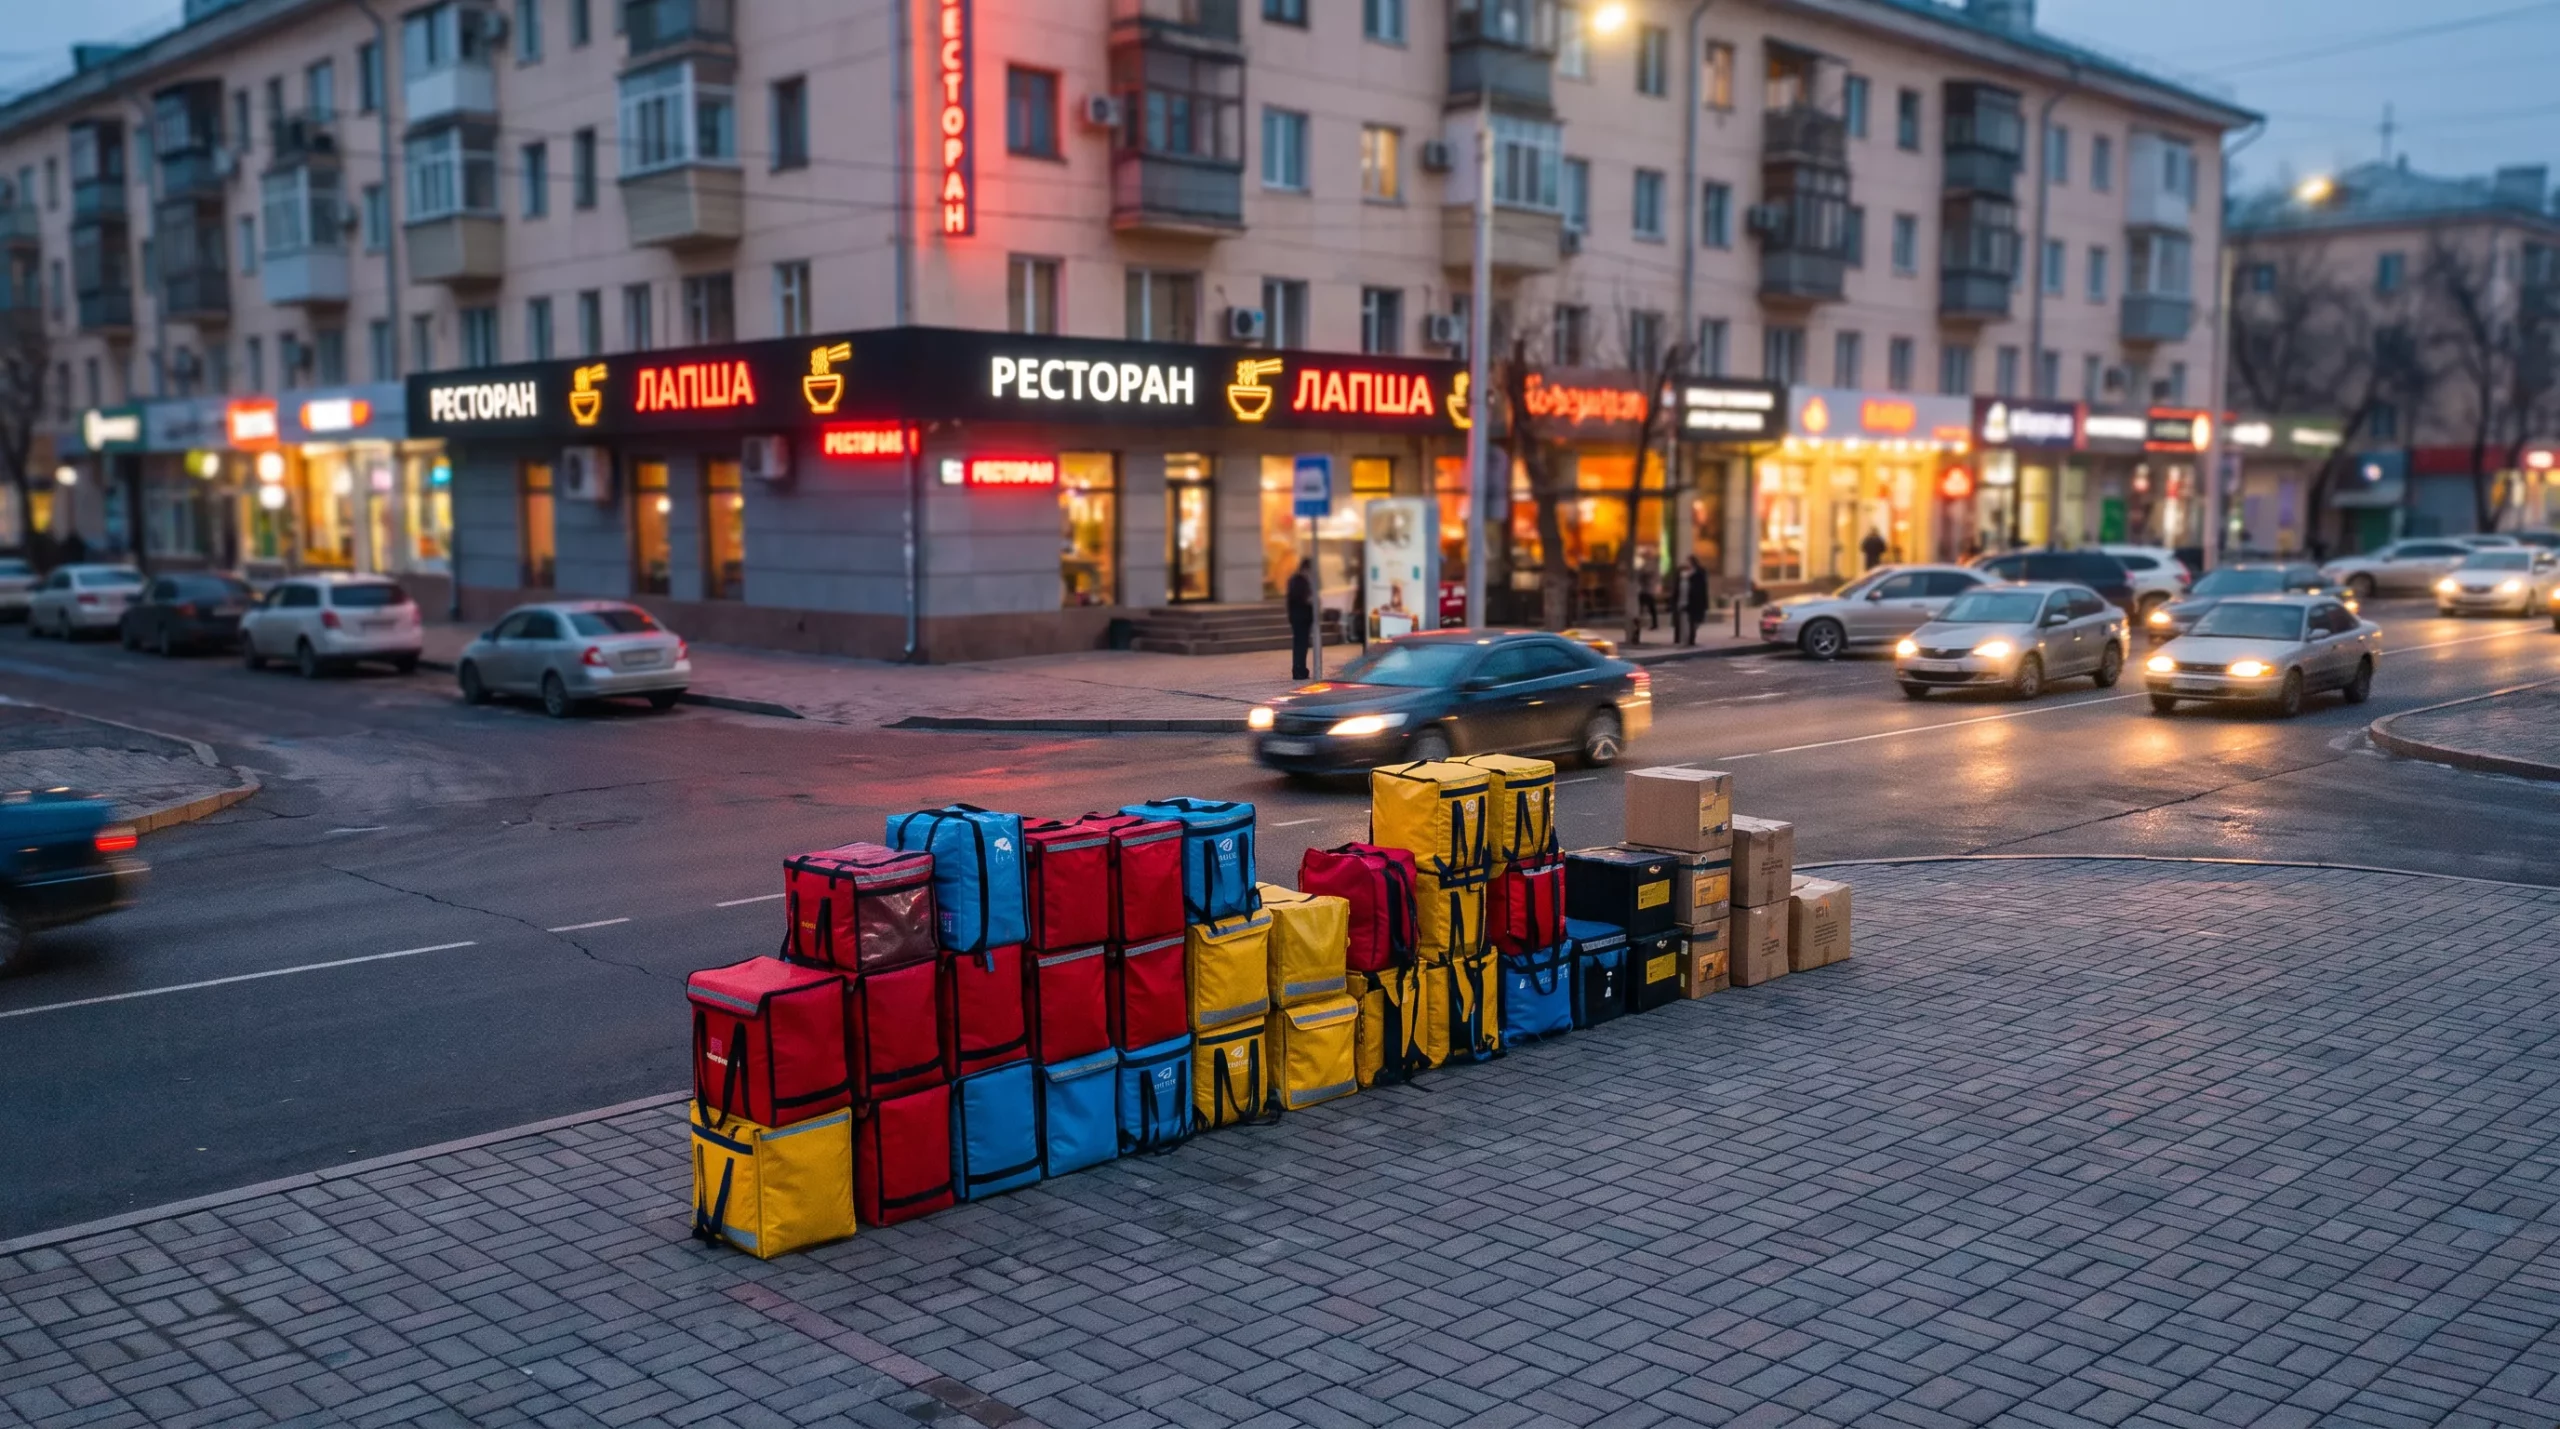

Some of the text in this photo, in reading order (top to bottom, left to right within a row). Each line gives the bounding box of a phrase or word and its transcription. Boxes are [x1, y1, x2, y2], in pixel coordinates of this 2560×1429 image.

[942, 0, 965, 232] ЕСТОРАН
[430, 381, 537, 421] РЕСТОРАН
[636, 361, 754, 411] ЛАПША
[991, 356, 1195, 405] РЕСТОРАН
[1293, 370, 1434, 415] ЛАПША
